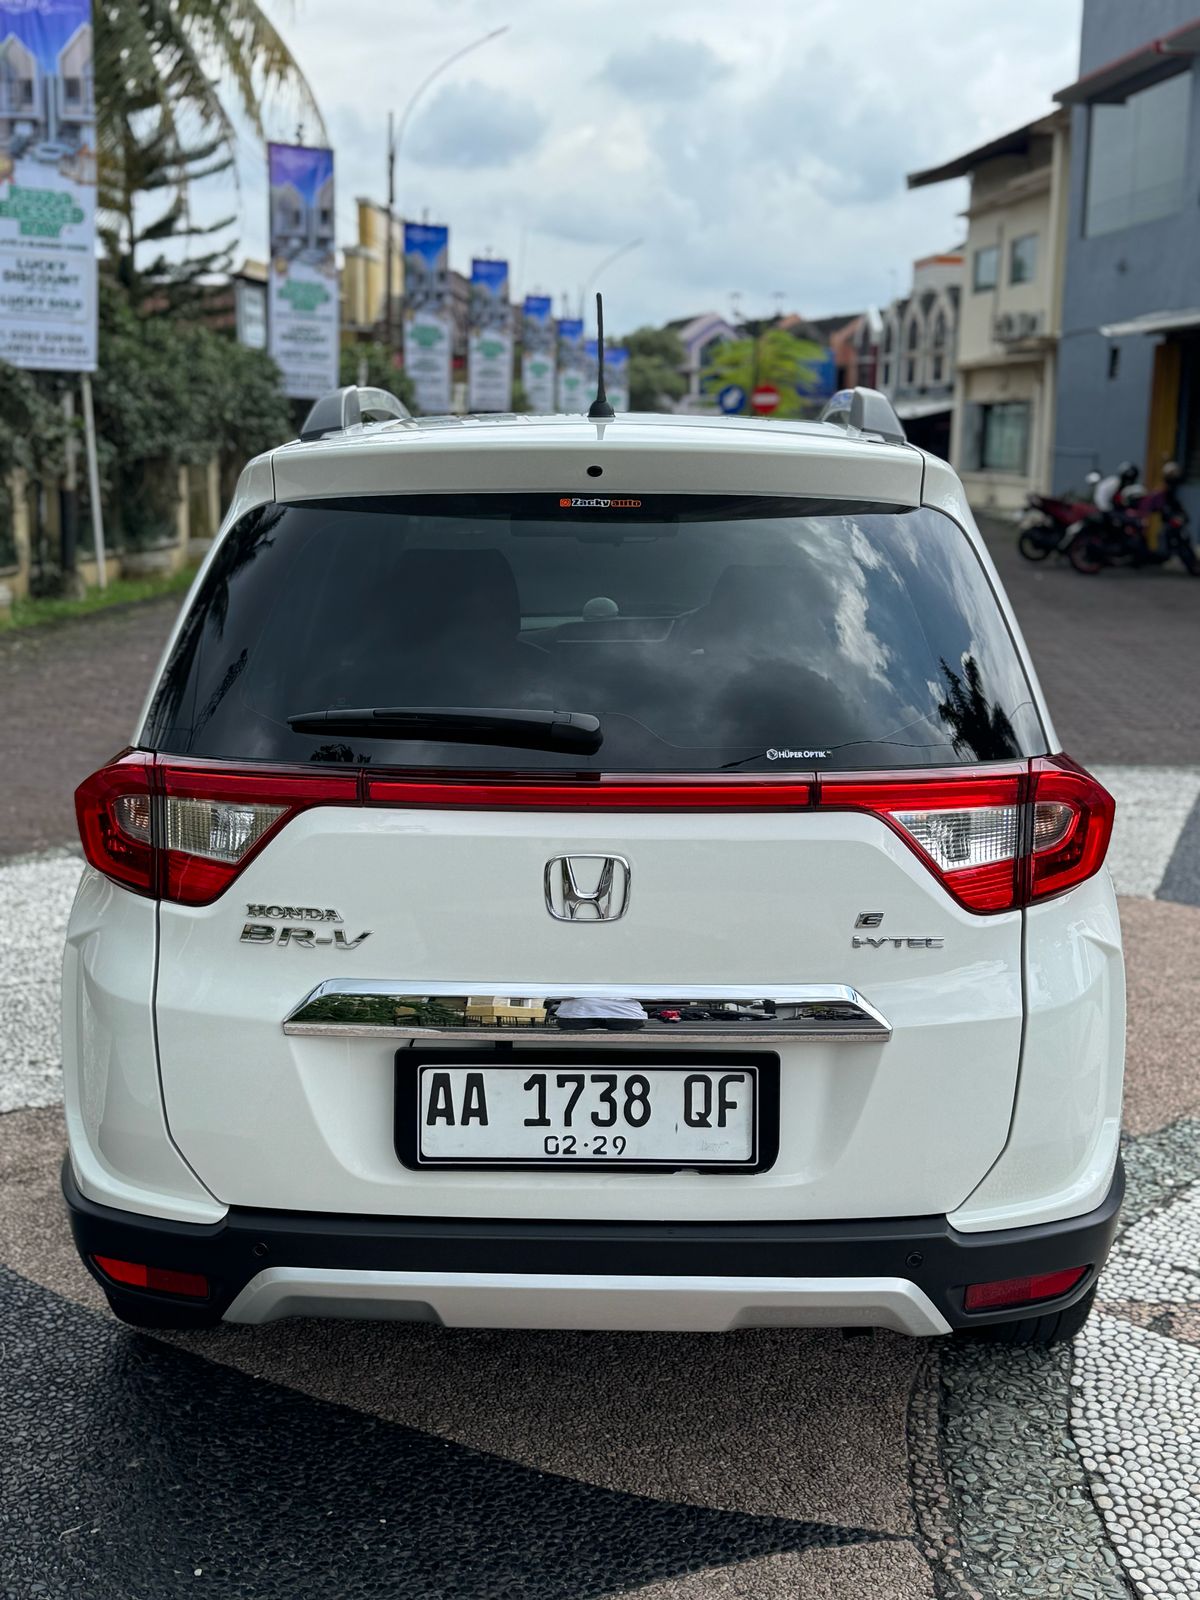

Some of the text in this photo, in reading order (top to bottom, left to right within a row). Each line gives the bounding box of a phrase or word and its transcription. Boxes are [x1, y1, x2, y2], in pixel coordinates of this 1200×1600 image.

[246, 903, 344, 923] HONDA
[239, 923, 375, 950] BR-V
[426, 1072, 746, 1128] AA 1738 QF
